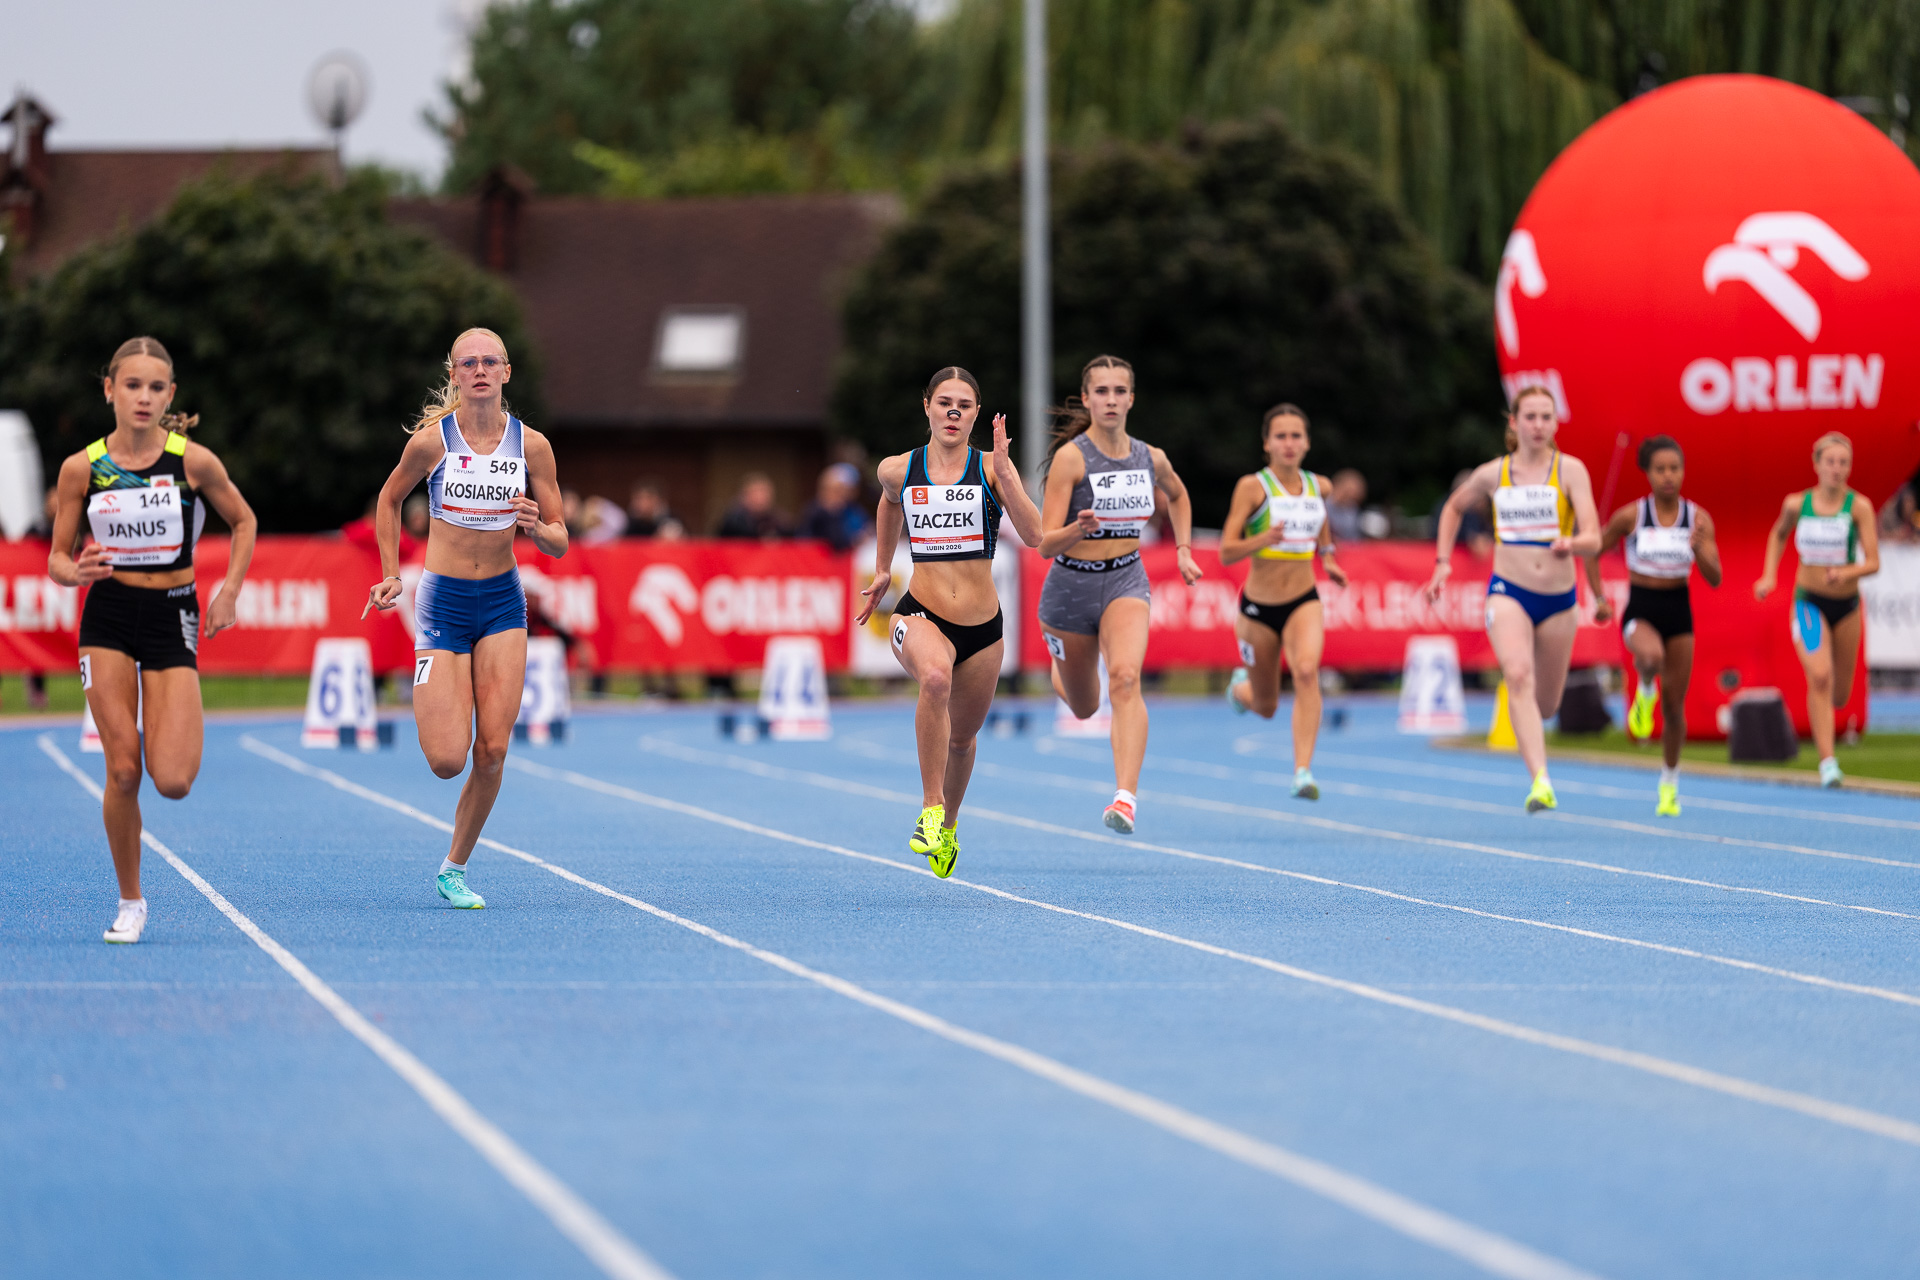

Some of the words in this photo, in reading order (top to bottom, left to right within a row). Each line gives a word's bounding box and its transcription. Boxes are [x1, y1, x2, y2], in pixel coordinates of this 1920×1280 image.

[1679, 354, 1885, 416] ORLEN
[490, 460, 518, 475] 549
[1126, 474, 1146, 486] 374
[140, 492, 171, 508] 144
[445, 482, 520, 501] KOSIARSKA
[945, 489, 975, 501] 866
[108, 520, 166, 538] JANUS
[911, 512, 974, 529] ZACZEK
[1066, 559, 1106, 571] PRO
[167, 585, 191, 598] NIKE
[702, 574, 846, 634] ORLEN
[1051, 637, 1060, 655] 5
[417, 659, 429, 682] 7
[318, 663, 343, 719] 6
